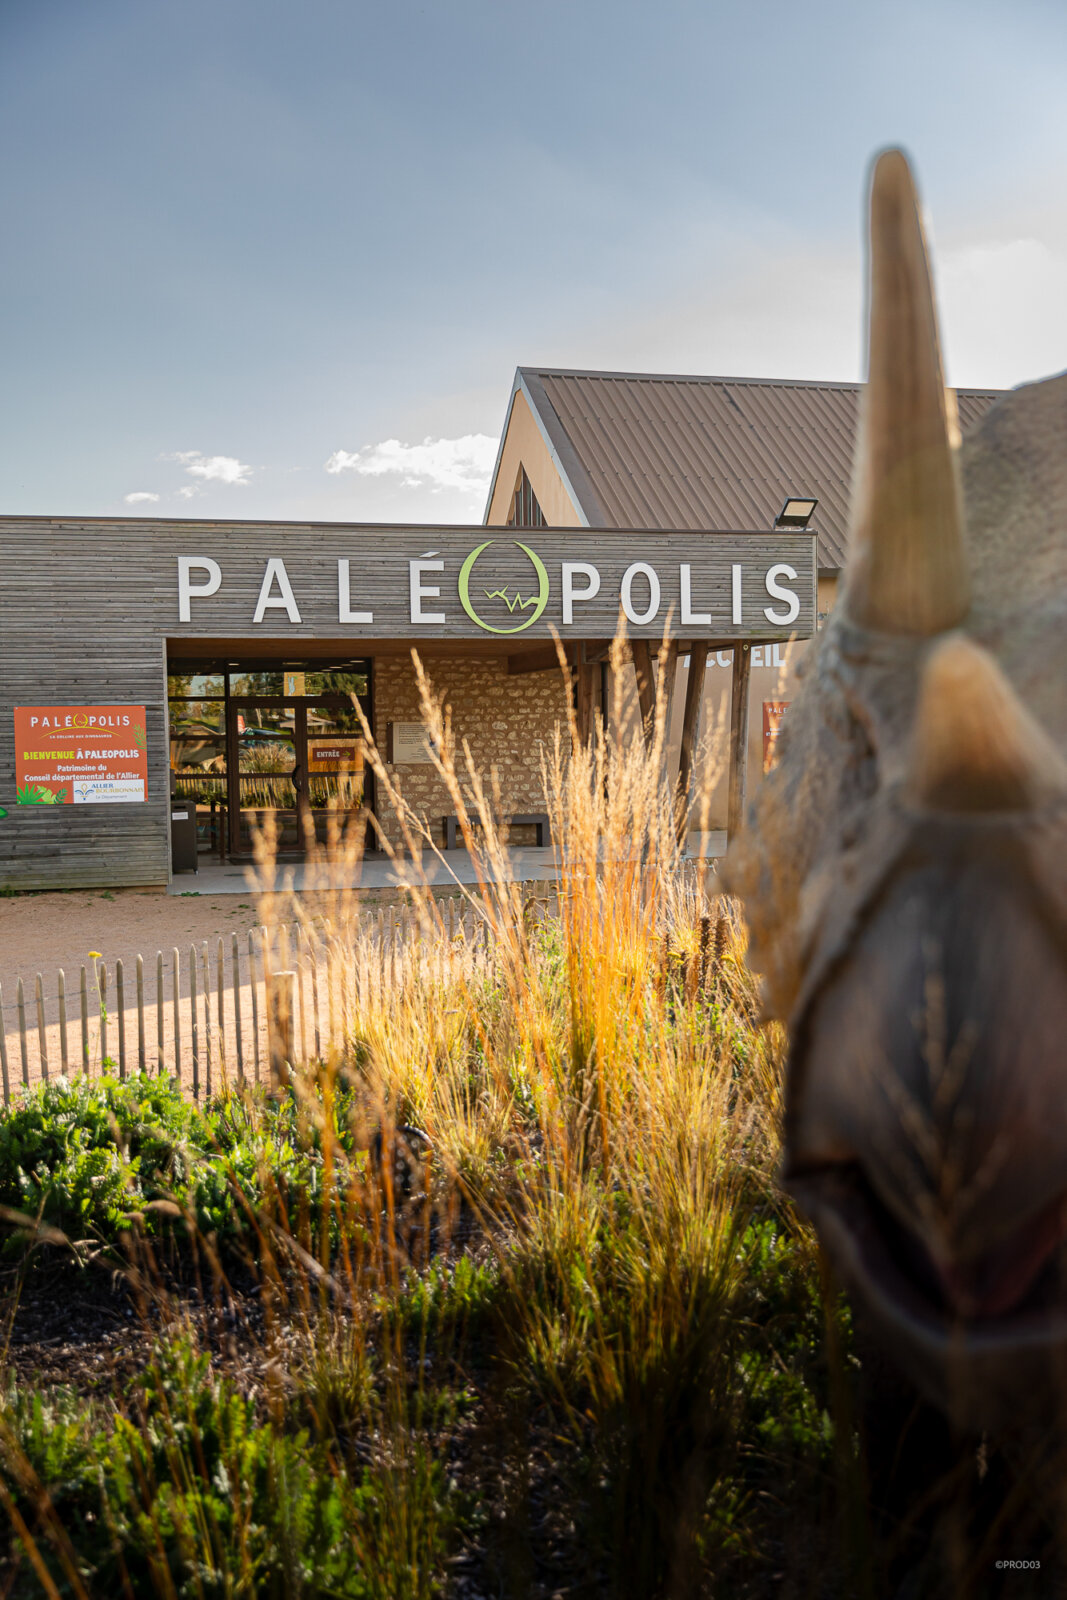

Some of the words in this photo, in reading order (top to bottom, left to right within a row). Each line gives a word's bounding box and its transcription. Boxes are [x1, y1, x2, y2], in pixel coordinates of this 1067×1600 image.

[177, 540, 800, 634] PALÉOPOLIS
[684, 643, 786, 668] CEIL
[31, 713, 130, 728] PALÉOPOLIS
[23, 751, 75, 760] BIENVENUE
[85, 749, 139, 759] PALEOPOLIS
[316, 750, 340, 758] ENTRÉE
[57, 764, 97, 772] Patrimoine
[24, 774, 51, 782] Conseil
[52, 773, 105, 782] départemental
[106, 772, 115, 780] de
